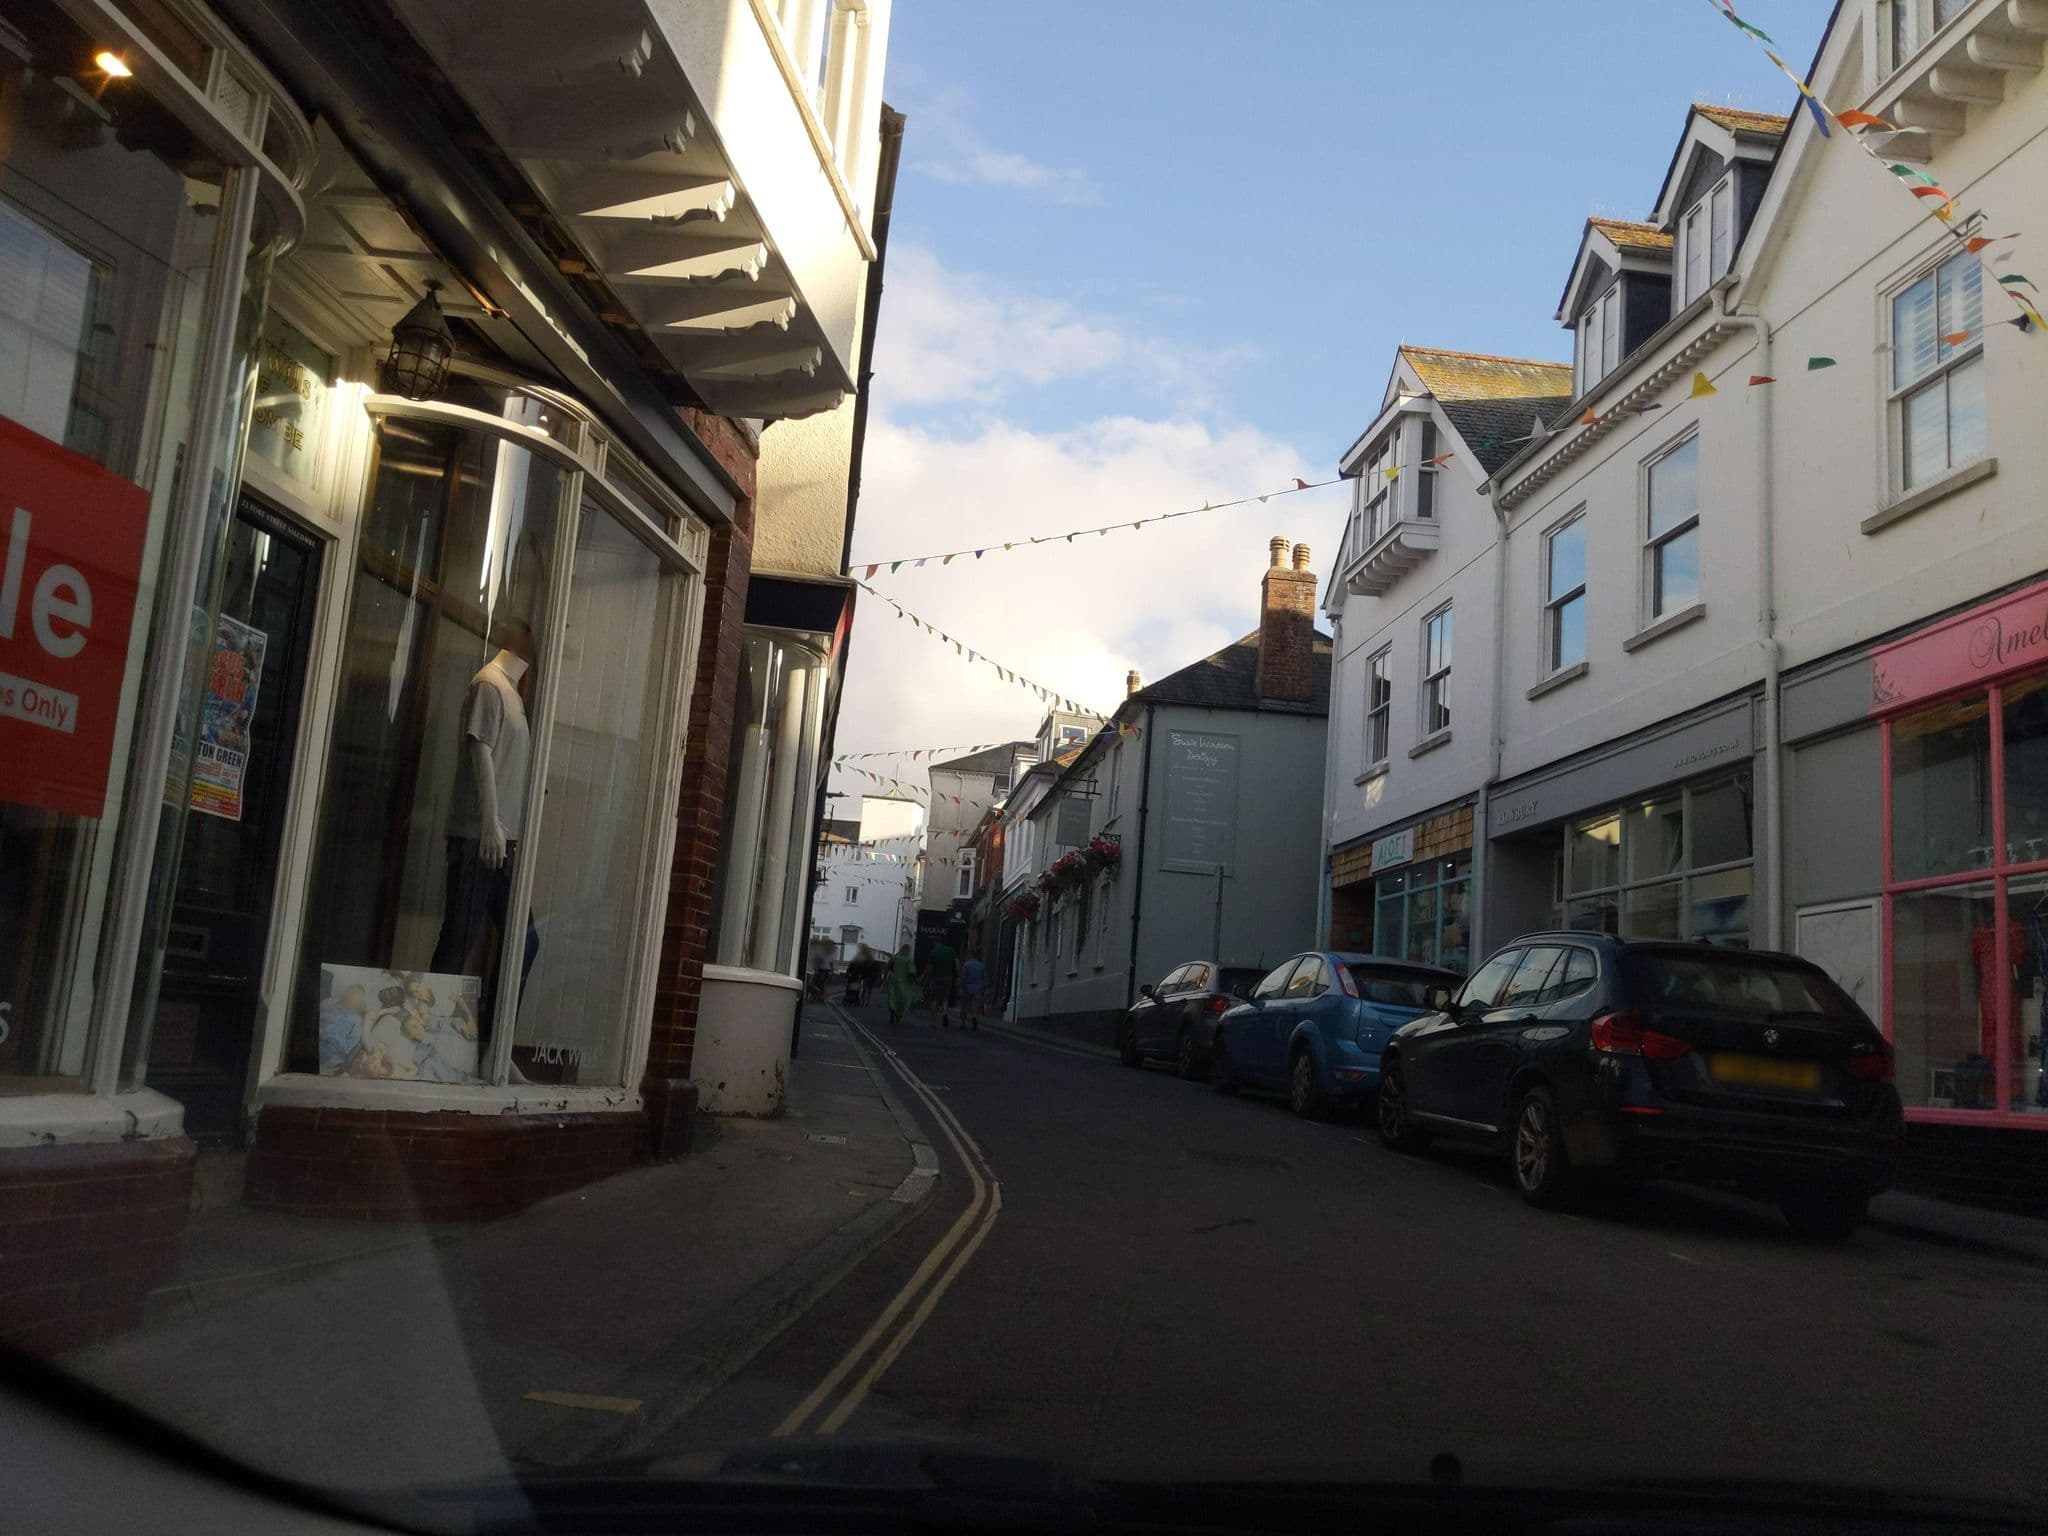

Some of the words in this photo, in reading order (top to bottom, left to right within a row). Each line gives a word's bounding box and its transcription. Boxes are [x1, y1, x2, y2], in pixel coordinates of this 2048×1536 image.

[22, 687, 70, 729] Only
[217, 747, 244, 768] GREEN
[1378, 834, 1407, 865] ALOFT
[531, 1040, 563, 1065] JACK
